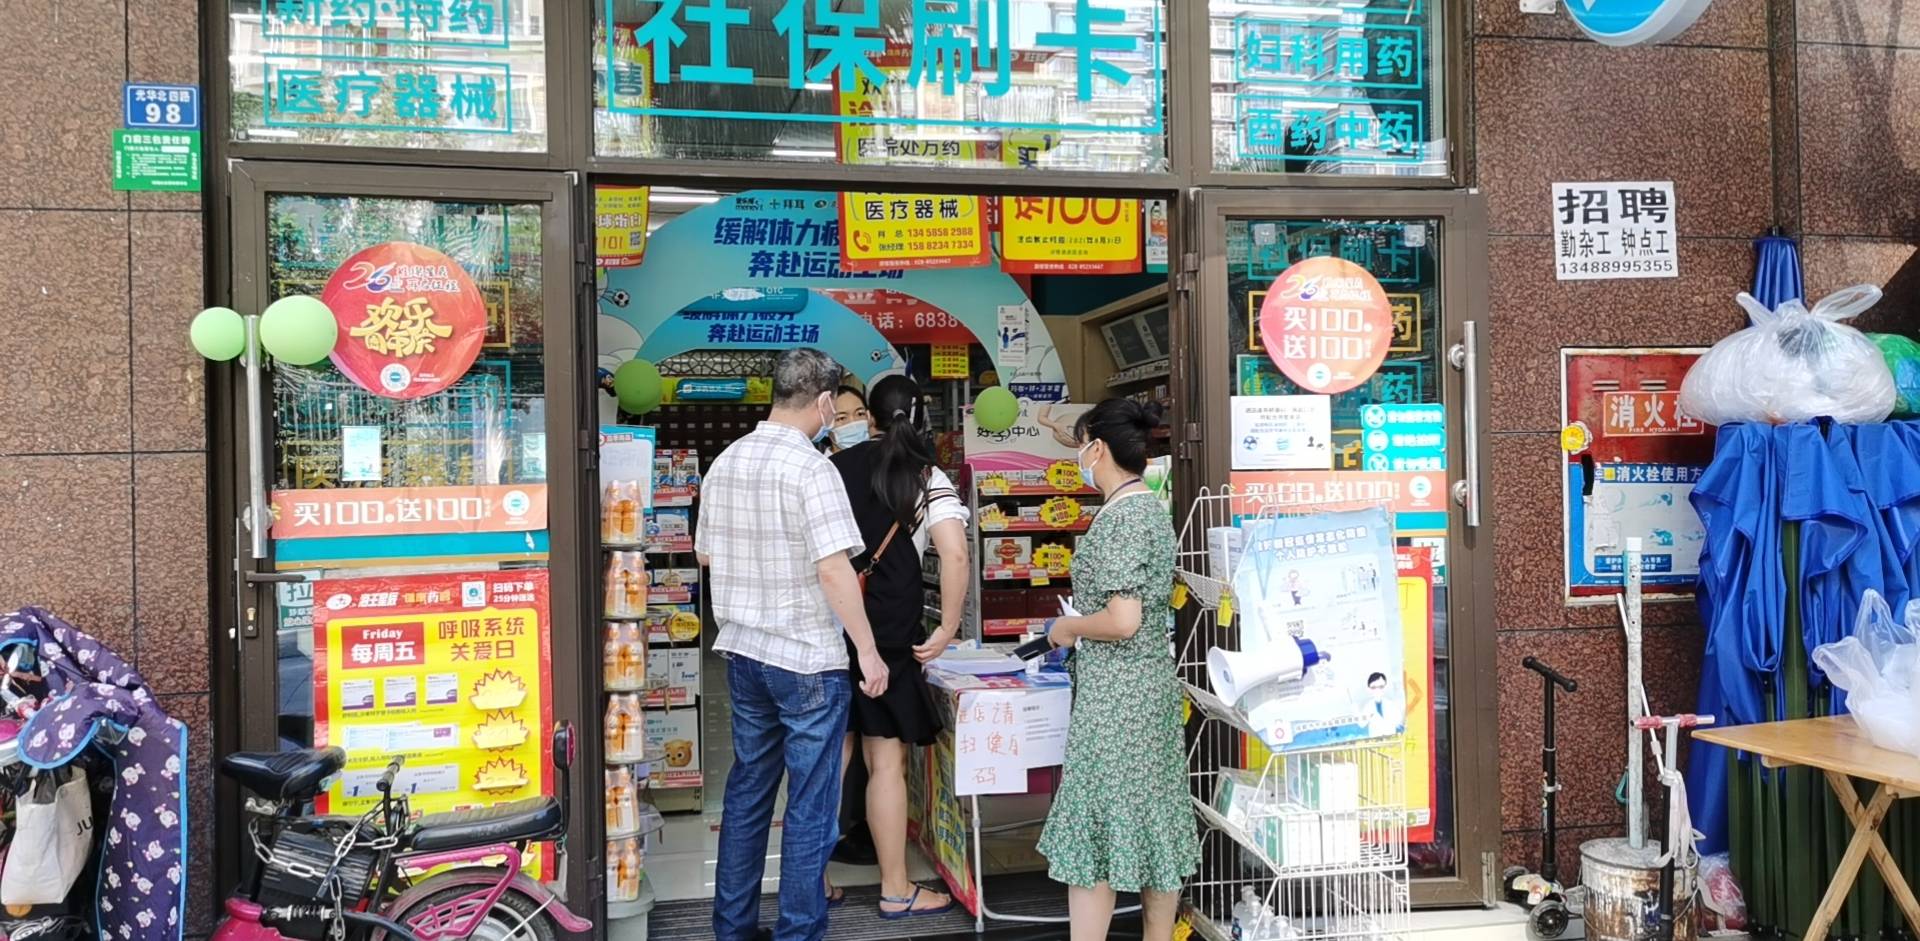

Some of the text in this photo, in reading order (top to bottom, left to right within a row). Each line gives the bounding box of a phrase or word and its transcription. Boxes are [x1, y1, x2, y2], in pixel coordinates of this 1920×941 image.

[632, 0, 1140, 101] 社保刷卡
[1247, 31, 1413, 77] 妇科用药
[277, 69, 497, 121] 医疗器械
[145, 103, 181, 123] 98
[1246, 109, 1413, 151] 西药中药
[864, 200, 959, 220] 医疗器械
[1558, 187, 1670, 225] 招聘
[713, 216, 840, 247] 缓解体力疲
[907, 228, 924, 238] 134
[926, 227, 949, 237] 5858
[1560, 228, 1670, 258] 勤杂工 钟点工
[908, 242, 925, 251] 158
[926, 241, 949, 250] 8234
[1559, 258, 1674, 277] 13488995355
[350, 296, 453, 339] 欢乐
[914, 312, 960, 328] 6838
[707, 323, 820, 344] 奔赴运动主场
[1610, 394, 1698, 428] 消火栓
[362, 627, 403, 641] Friday
[438, 616, 525, 640] 呼吸系统
[351, 640, 417, 664] 每周五
[450, 639, 515, 662] 关爱日
